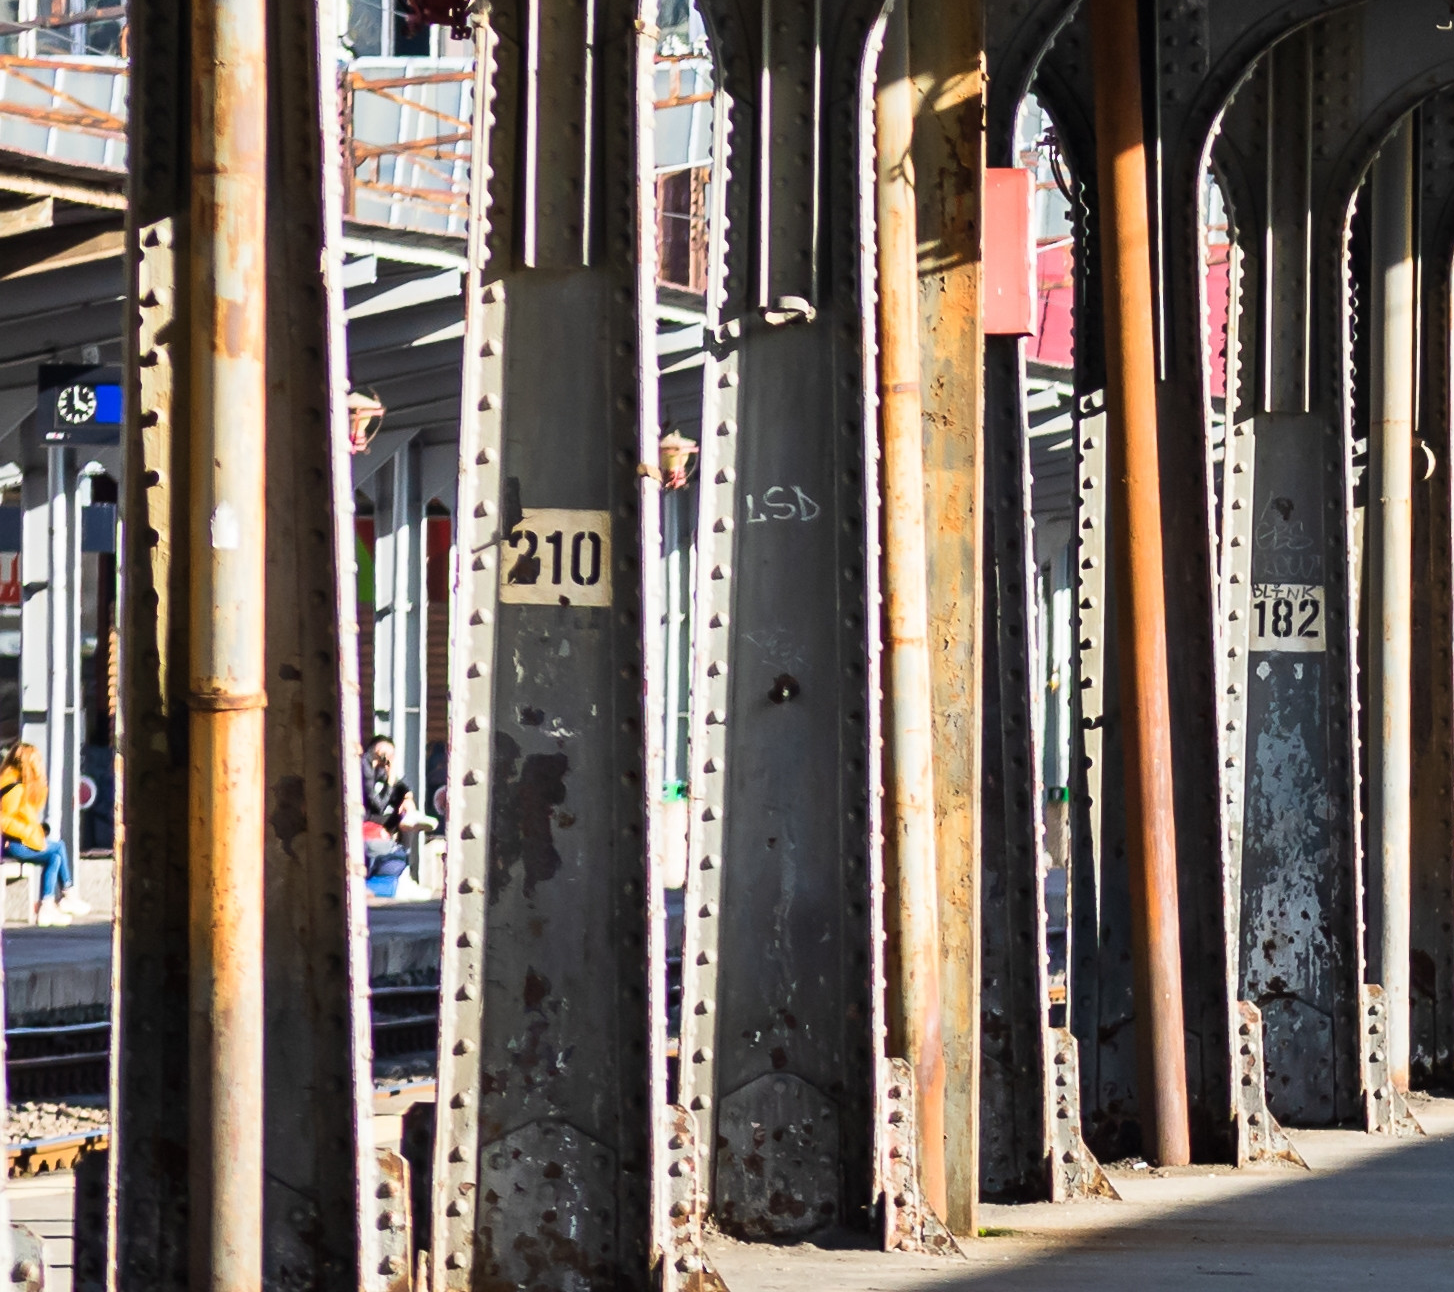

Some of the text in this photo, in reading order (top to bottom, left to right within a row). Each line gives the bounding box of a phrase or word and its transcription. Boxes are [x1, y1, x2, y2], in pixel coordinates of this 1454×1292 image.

[746, 486, 820, 523] LSD
[508, 530, 601, 586] 210
[1254, 599, 1320, 638] 182
